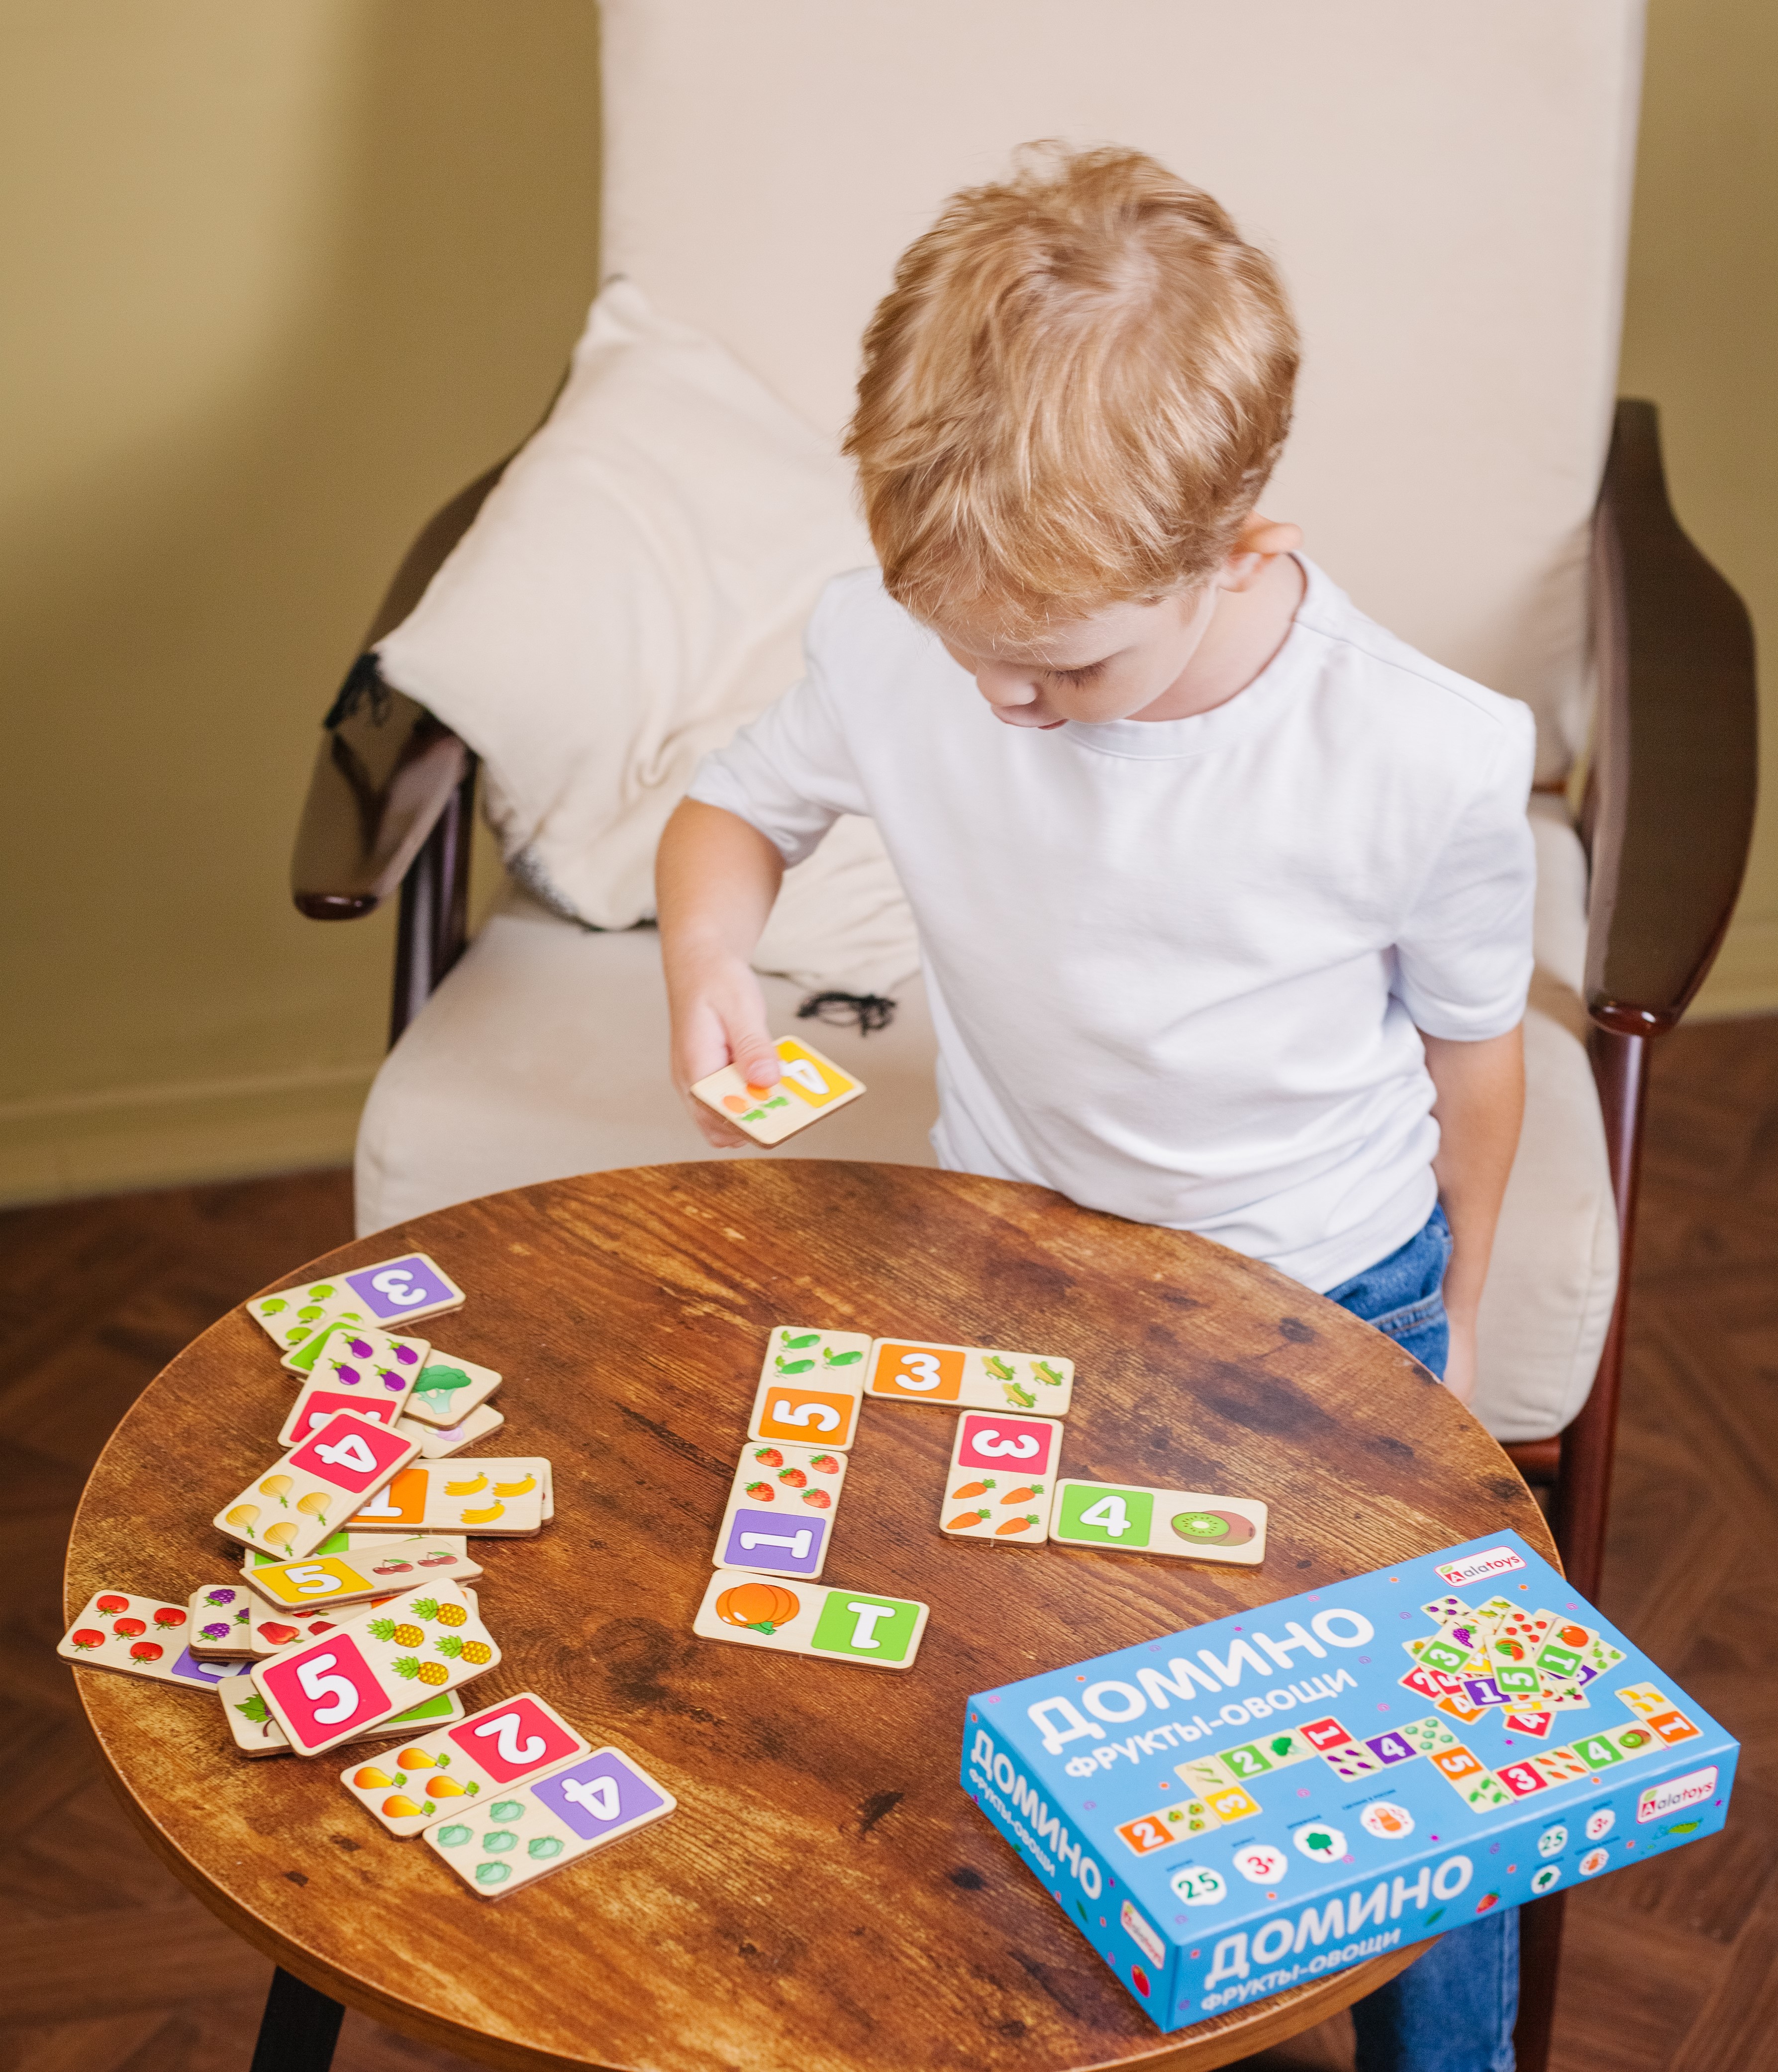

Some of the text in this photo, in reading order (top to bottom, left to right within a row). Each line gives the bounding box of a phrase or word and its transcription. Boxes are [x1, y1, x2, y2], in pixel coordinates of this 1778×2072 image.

[372, 1269, 427, 1306] 3
[895, 1353, 942, 1391] 3
[772, 1400, 841, 1432] 5
[314, 1434, 377, 1473] 4
[972, 1429, 1040, 1459] 3
[1079, 1495, 1132, 1538] 4
[740, 1529, 813, 1559] 1
[285, 1565, 342, 1594] 5
[847, 1601, 896, 1649] 1
[1429, 1649, 1461, 1667] 3
[1544, 1654, 1576, 1671] 1
[297, 1653, 360, 1725] 5
[1027, 1608, 1375, 1756] ДОМИНО
[1475, 1681, 1502, 1703] 1
[1501, 1673, 1534, 1687] 5
[1064, 1668, 1359, 1778] ФРУКТЫ-ОВОЩИ
[1308, 1725, 1341, 1746] 1
[1659, 1716, 1691, 1736] 1
[474, 1713, 547, 1765] 2
[1381, 1737, 1406, 1759] 4
[1588, 1740, 1612, 1762] 4
[1232, 1750, 1263, 1774] 2
[1441, 1754, 1476, 1772] 5
[1507, 1768, 1537, 1791] 3
[561, 1776, 621, 1821] 4
[1216, 1794, 1248, 1814] 3
[971, 1729, 1102, 1900] ДОМИНО
[1132, 1822, 1165, 1848] 2
[1177, 1872, 1219, 1899] 25
[1204, 1855, 1473, 1990] ДОМИНО
